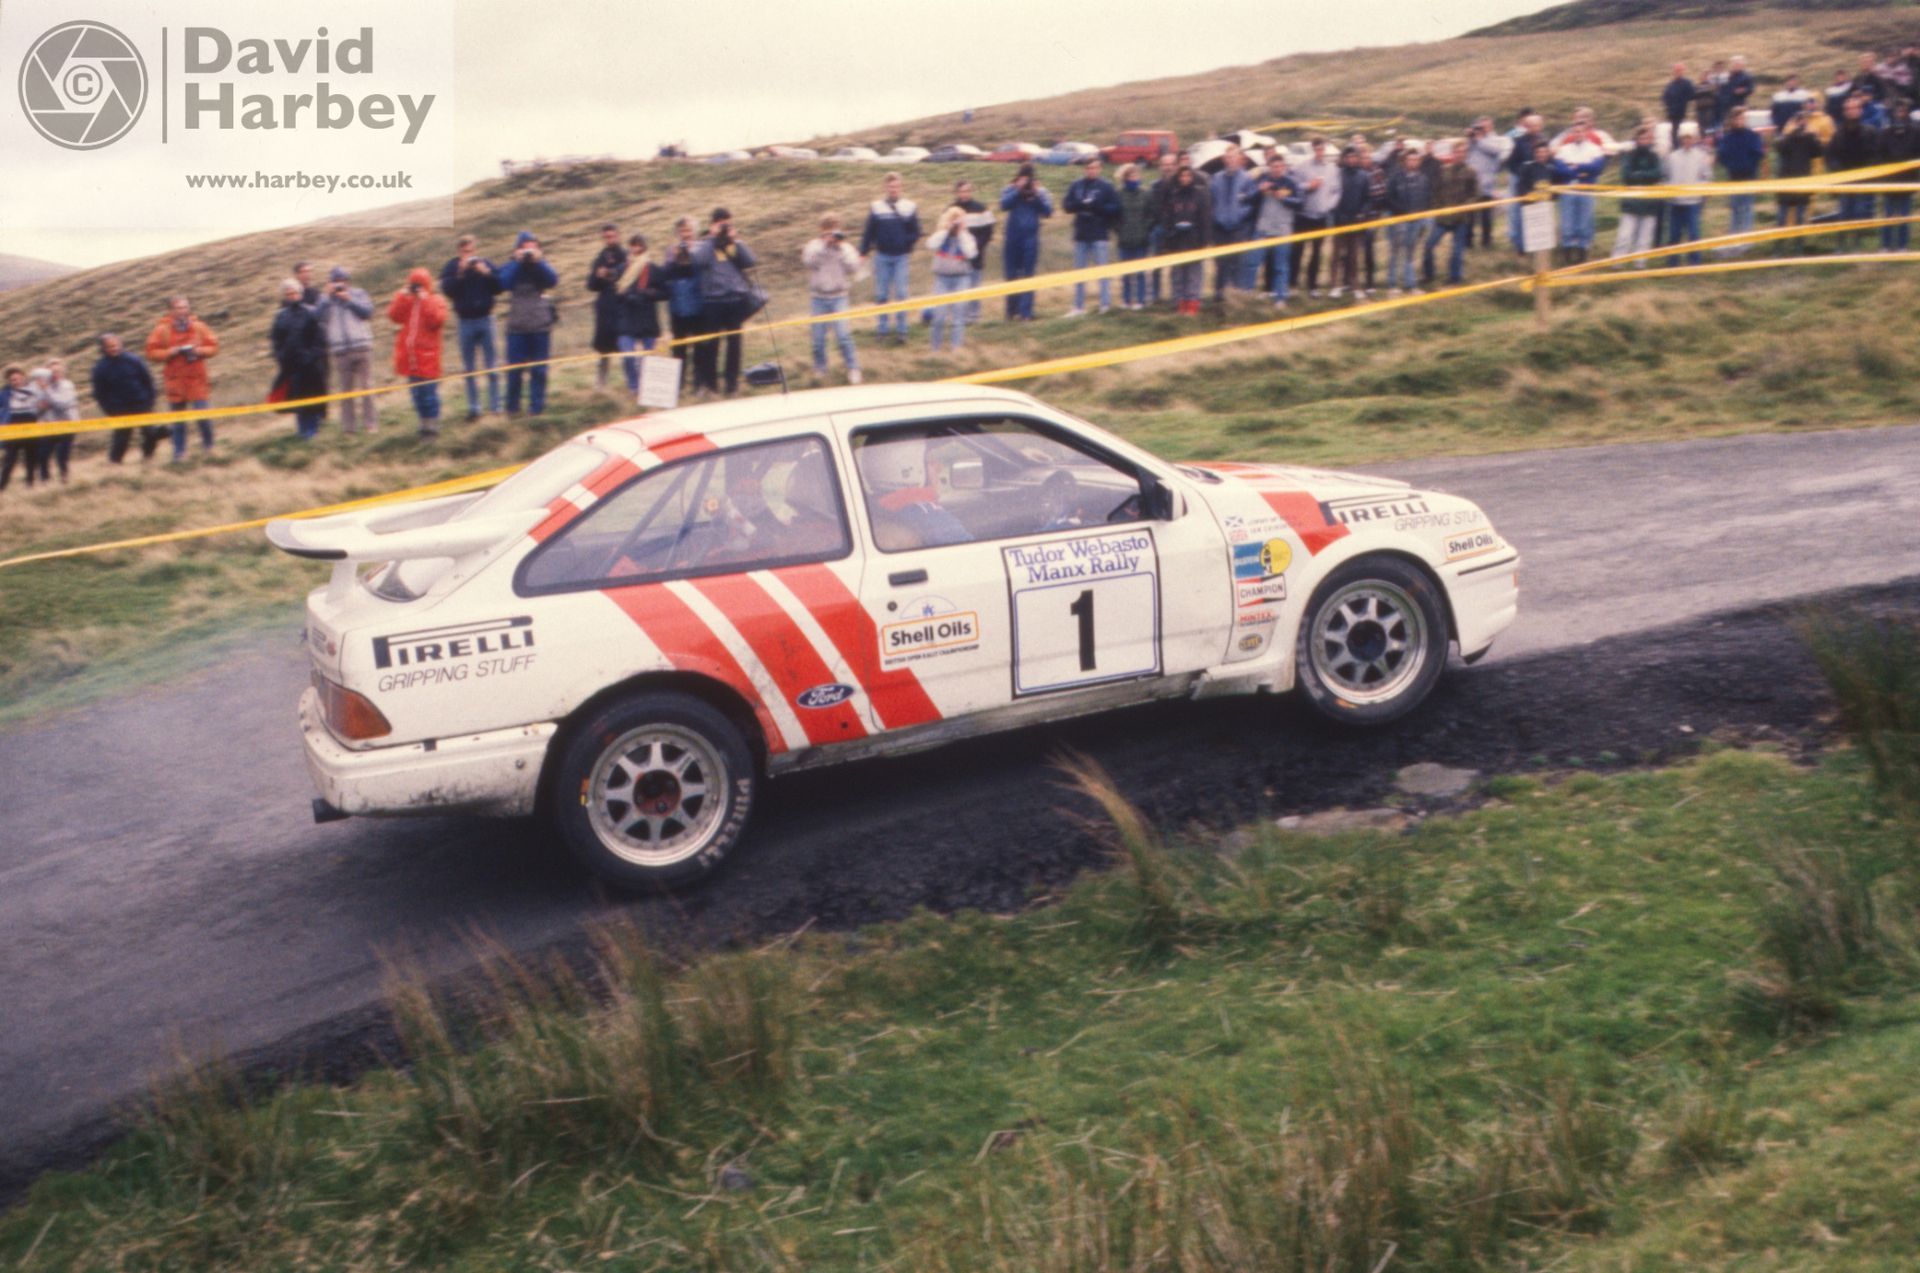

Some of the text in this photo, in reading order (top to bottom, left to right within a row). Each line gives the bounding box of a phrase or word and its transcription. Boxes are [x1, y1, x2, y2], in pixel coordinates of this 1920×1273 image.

[1319, 493, 1430, 526] PIRELLI
[1394, 512, 1450, 532] GRIPPING
[1009, 536, 1150, 568] Tudor Webasto
[1448, 534, 1494, 553] Shell Oils
[1027, 553, 1140, 584] Manx Rally
[1239, 583, 1284, 599] CHAMPION
[371, 615, 535, 670] PIRELLI
[890, 620, 972, 647] Shell Oils
[1070, 588, 1097, 672] 1
[378, 653, 538, 692] GRIPPING STUFF
[808, 686, 845, 706] Ford
